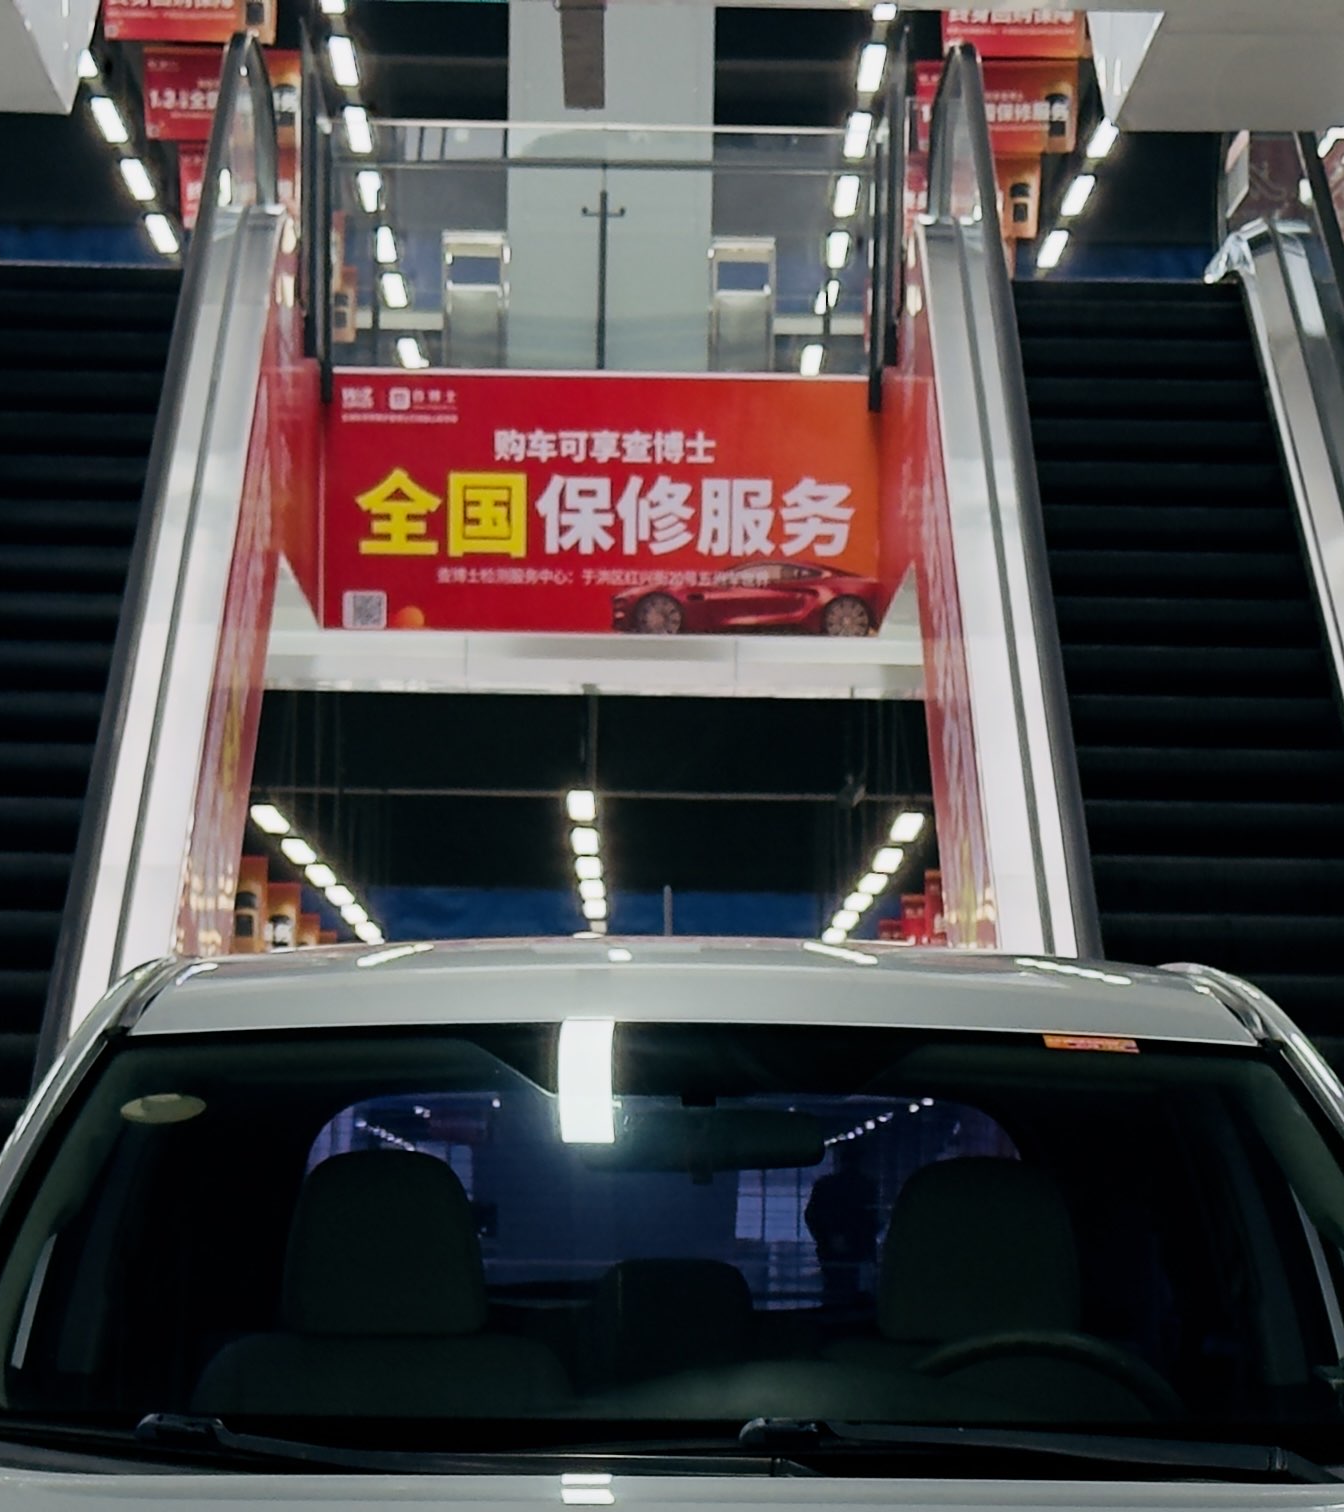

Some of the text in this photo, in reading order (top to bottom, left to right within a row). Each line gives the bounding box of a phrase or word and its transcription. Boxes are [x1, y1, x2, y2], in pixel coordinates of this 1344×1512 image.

[493, 429, 716, 465] 购车可享查博士
[355, 467, 856, 559] 全国保修服务
